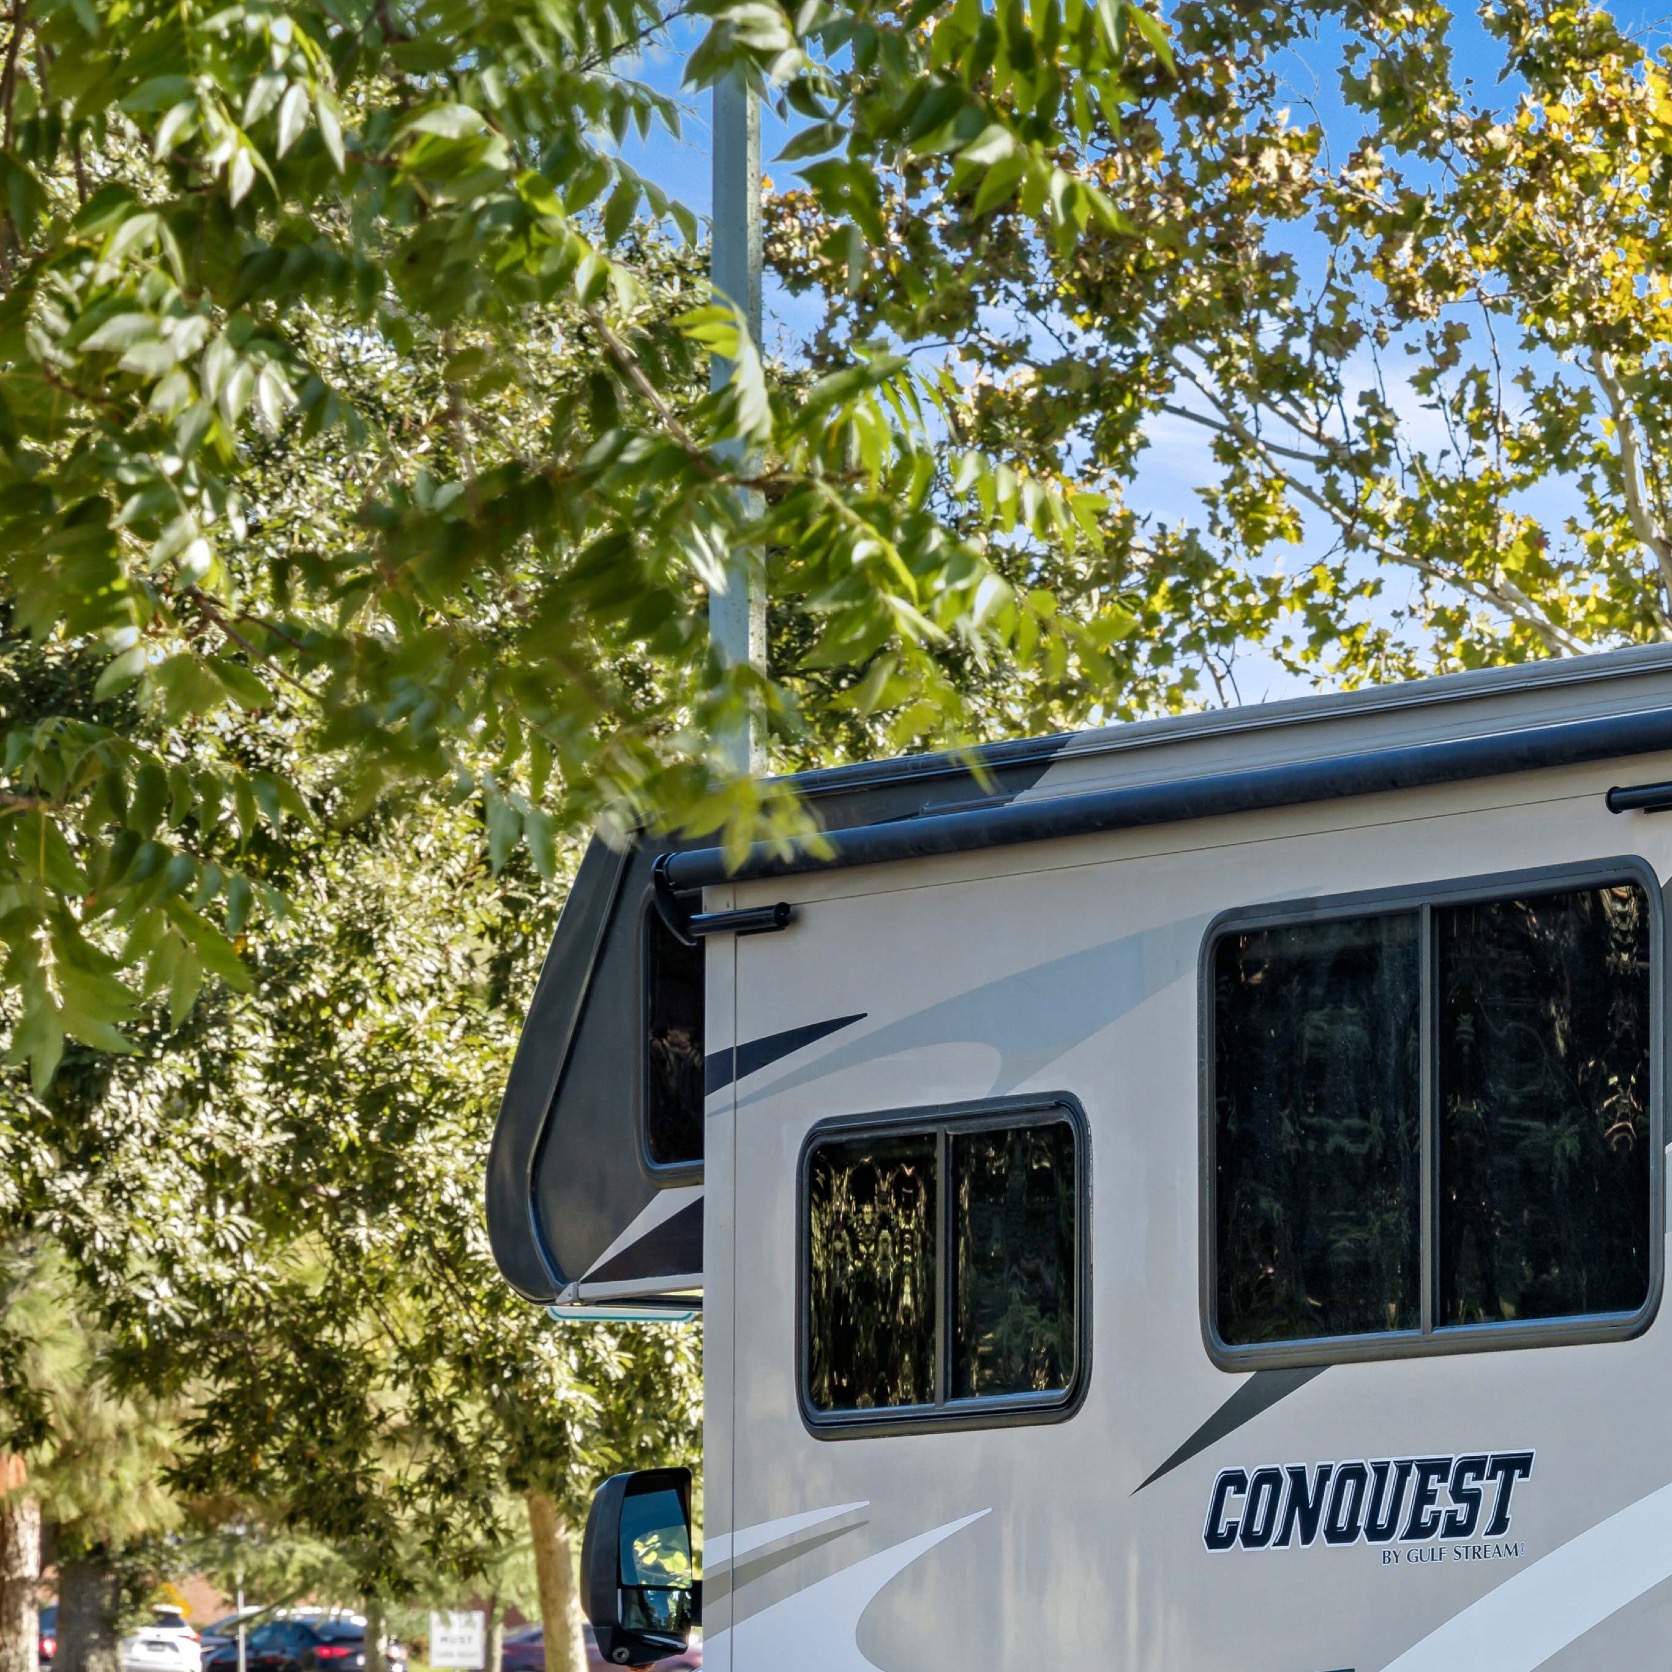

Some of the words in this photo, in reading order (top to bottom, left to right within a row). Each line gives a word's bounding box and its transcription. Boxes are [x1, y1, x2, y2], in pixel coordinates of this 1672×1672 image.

[1203, 1450, 1536, 1552] CONQUEST
[1382, 1549, 1401, 1565] BY
[1406, 1546, 1447, 1563] GULF
